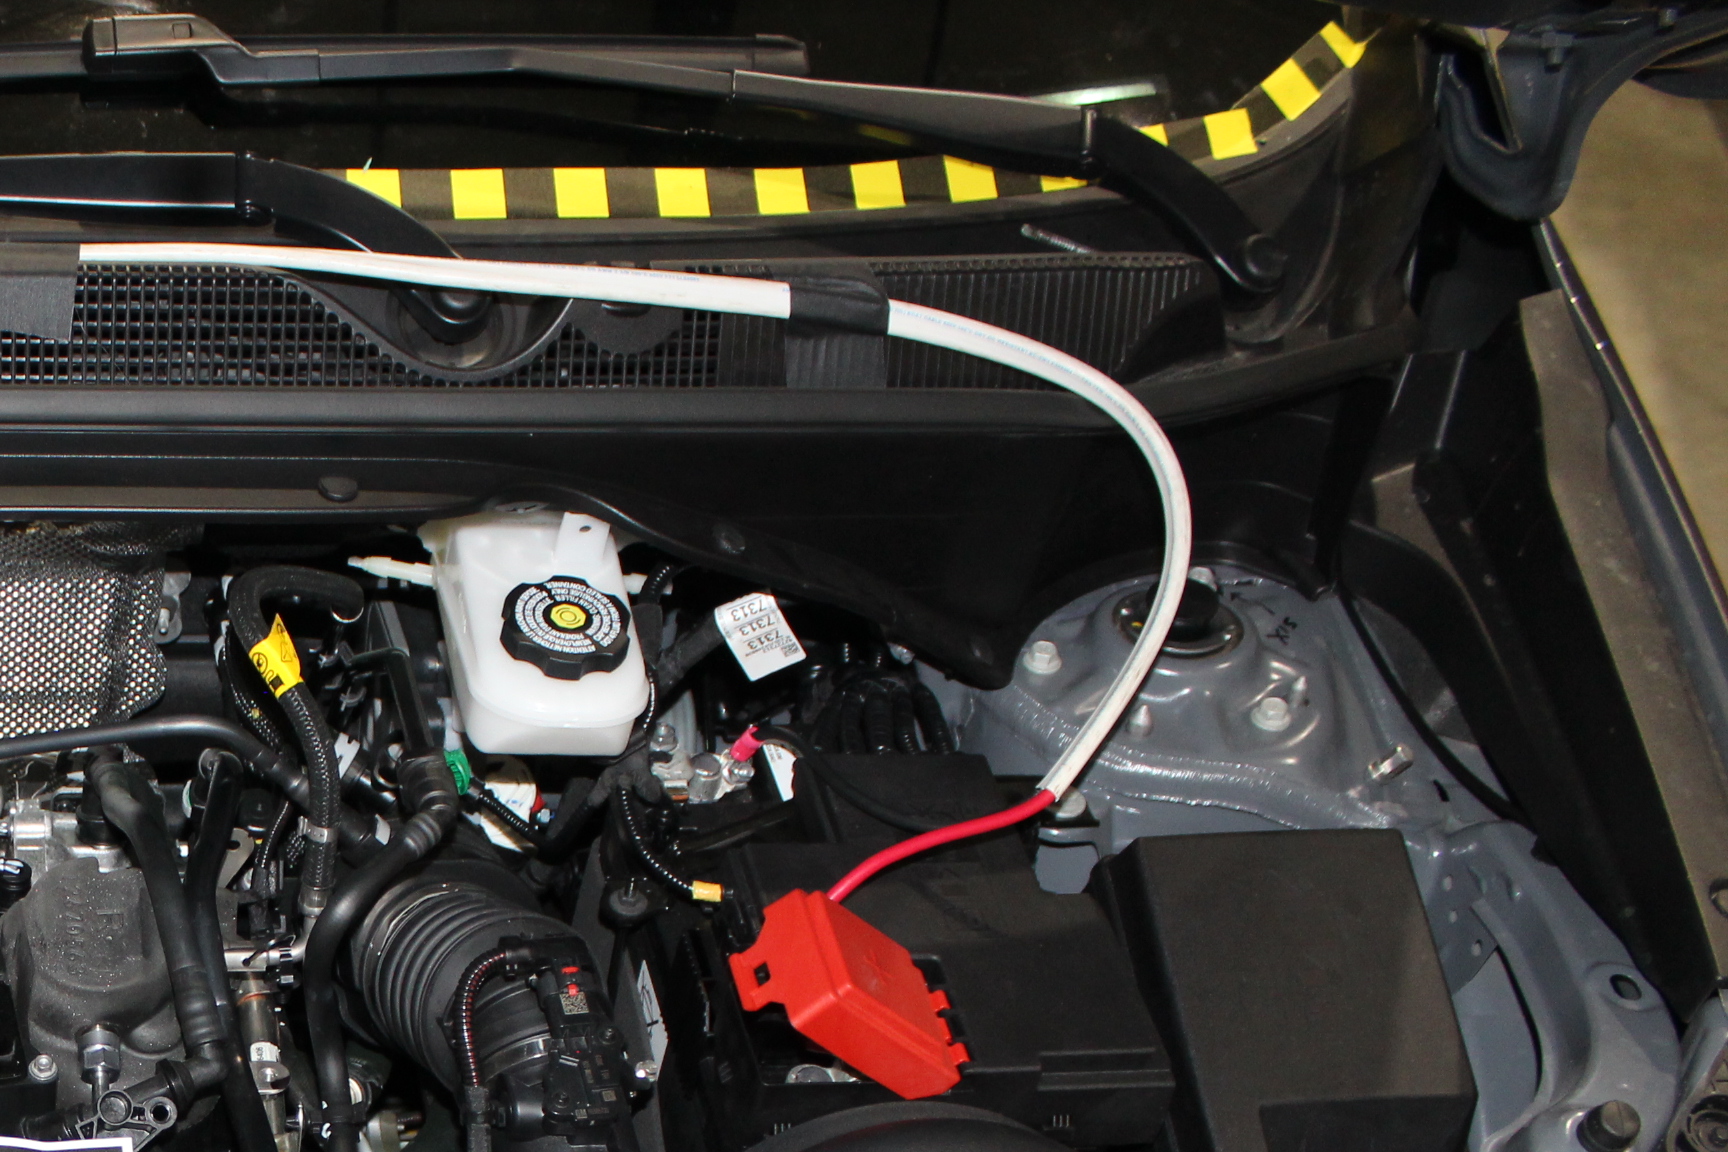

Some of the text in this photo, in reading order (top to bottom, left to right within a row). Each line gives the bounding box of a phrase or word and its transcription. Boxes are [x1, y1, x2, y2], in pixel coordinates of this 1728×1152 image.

[730, 599, 767, 621] 7313
[739, 615, 775, 636] 7313
[563, 644, 598, 653] ATTENTION
[746, 630, 782, 650] 7313
